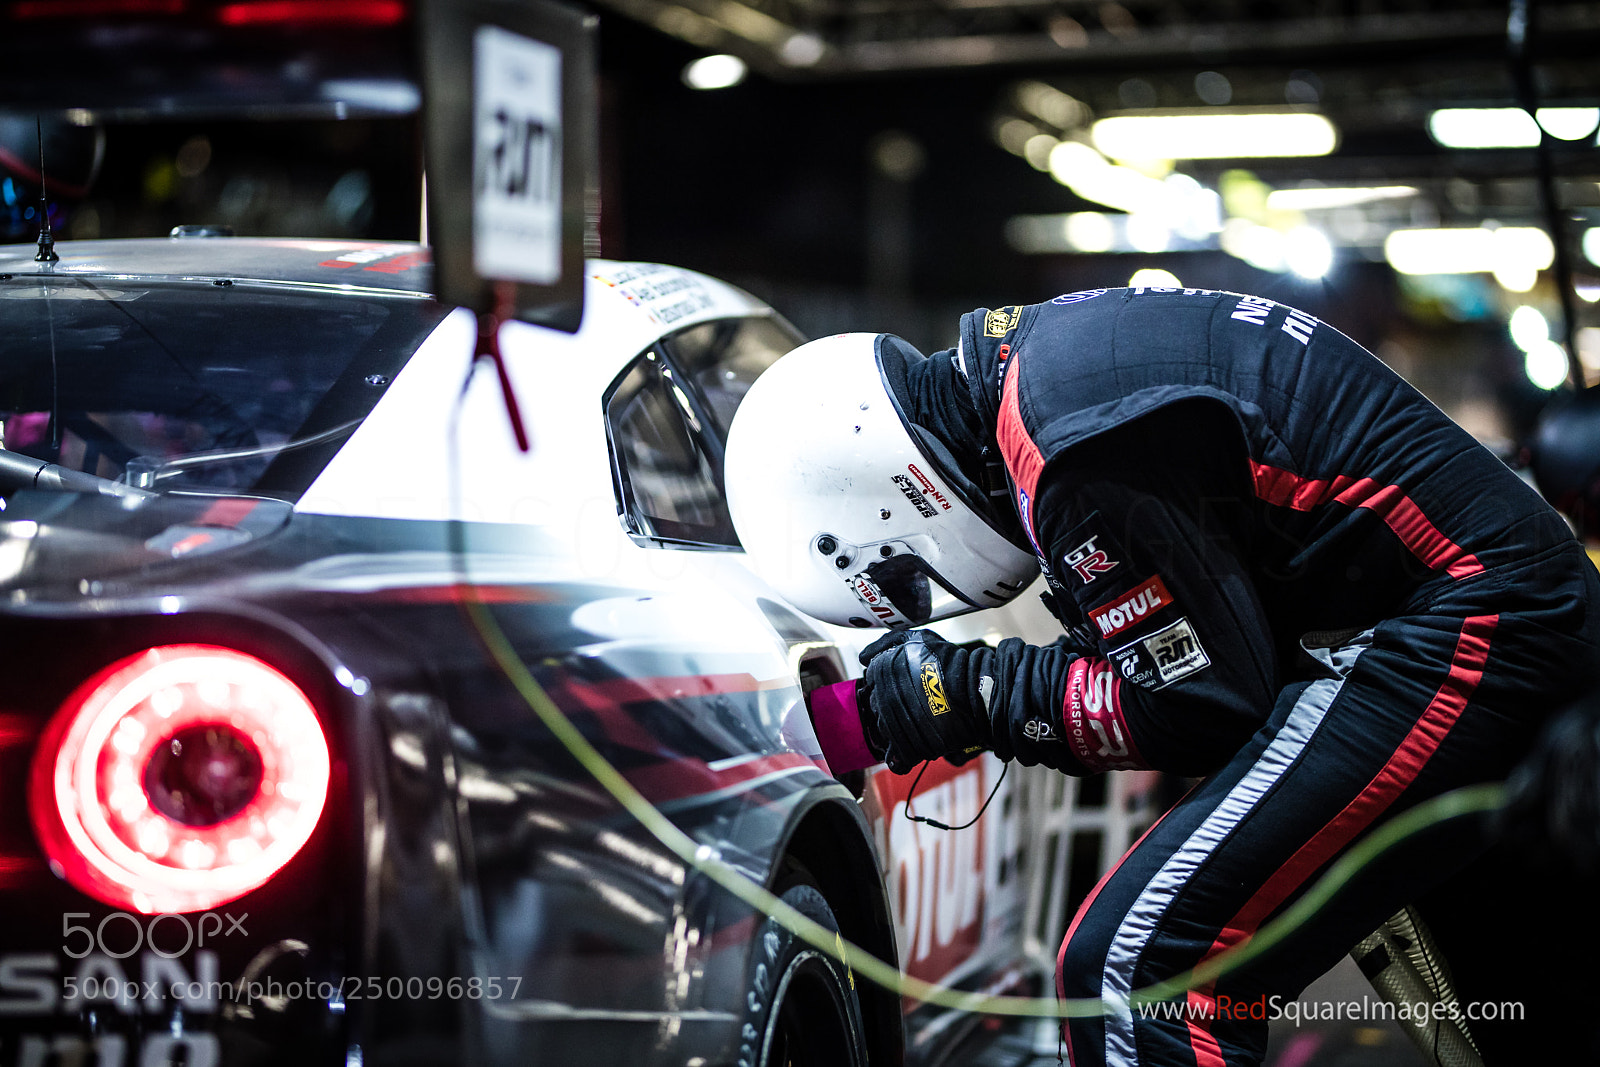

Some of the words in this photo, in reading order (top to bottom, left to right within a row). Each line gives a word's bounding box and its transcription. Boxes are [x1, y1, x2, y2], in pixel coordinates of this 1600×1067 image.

[932, 490, 953, 511] RJN
[1063, 535, 1098, 566] GT
[1071, 550, 1120, 584] R
[857, 580, 878, 604] BELL
[1095, 586, 1162, 636] MOTUL
[1159, 633, 1177, 645] TEAM
[1162, 652, 1202, 676] MOTORSPORT
[1069, 669, 1091, 757] MOTORSPORTS
